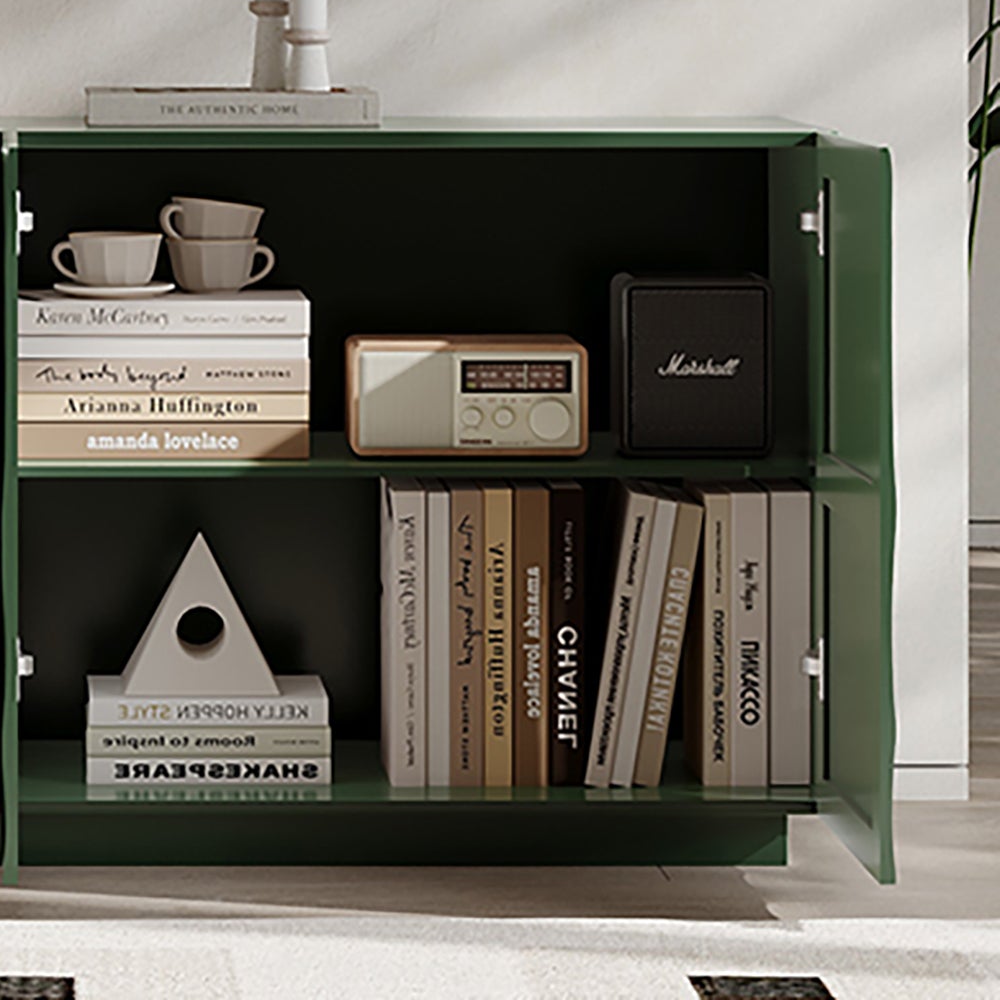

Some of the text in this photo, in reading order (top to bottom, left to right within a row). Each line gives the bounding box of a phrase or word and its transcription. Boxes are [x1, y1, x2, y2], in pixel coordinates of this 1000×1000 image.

[160, 104, 299, 114] THE AUTHENTIC HOME
[35, 308, 83, 325] Karen
[86, 307, 169, 330] McCartney
[35, 366, 72, 384] The
[657, 351, 741, 377] Marshall
[63, 396, 259, 418] Arianna Huffington
[86, 431, 240, 450] amanda lovelace
[712, 609, 725, 697] ПОХИТИТЕЛЬ
[739, 640, 761, 726] ПИКАССО
